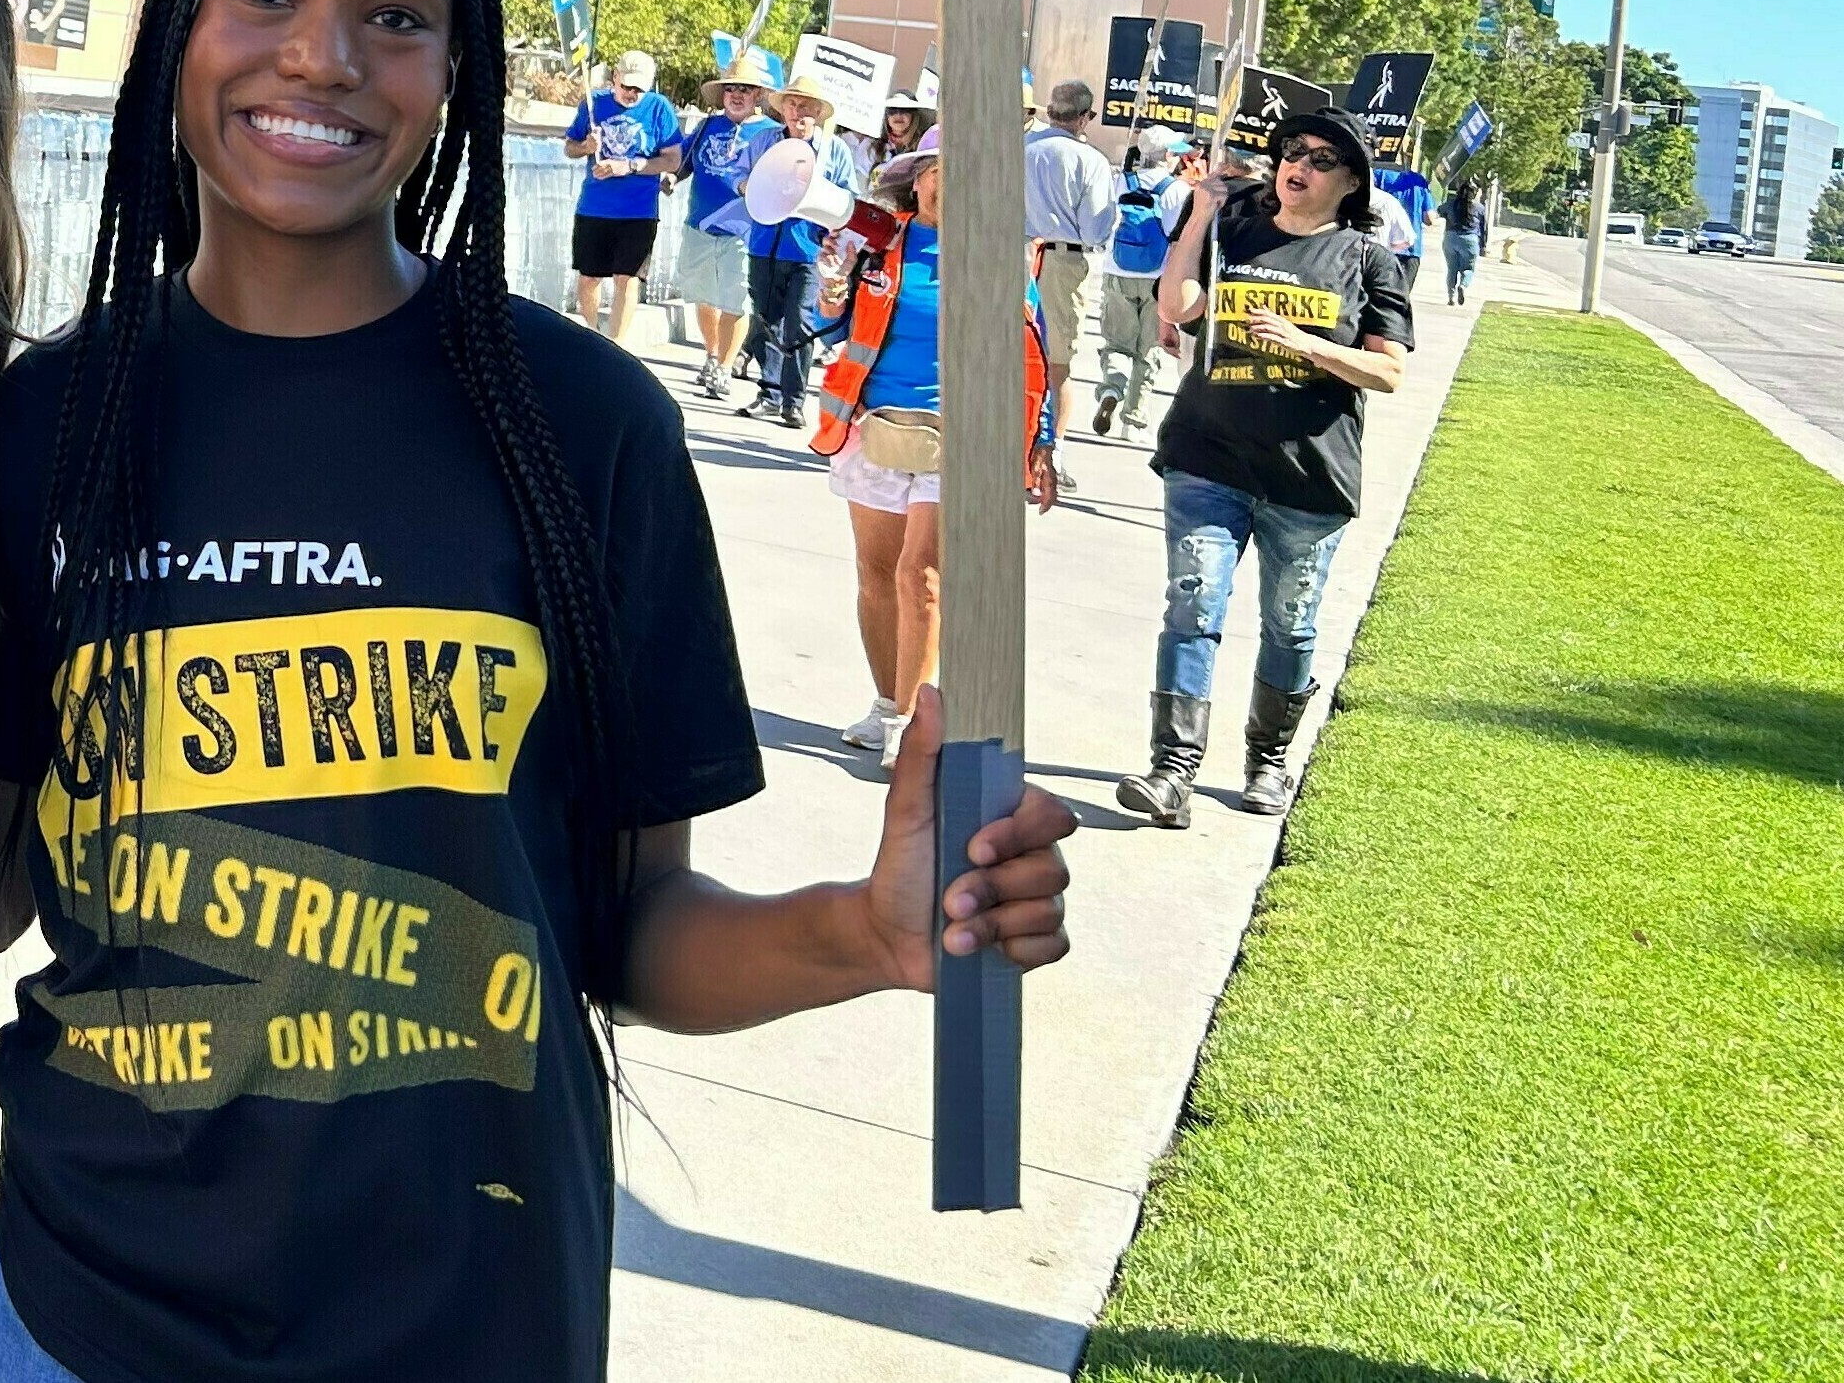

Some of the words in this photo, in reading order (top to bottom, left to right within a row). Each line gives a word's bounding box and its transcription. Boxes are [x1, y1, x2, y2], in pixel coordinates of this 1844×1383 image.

[1106, 100, 1193, 124] STRIKE!
[1109, 78, 1196, 98] SAGAFTRA
[1244, 289, 1330, 320] STRIKE
[176, 639, 517, 775] STRIKE
[109, 833, 190, 924] ON
[204, 857, 430, 987] STRIKE
[76, 1020, 213, 1085] TRIKE
[267, 1010, 334, 1072] ON
